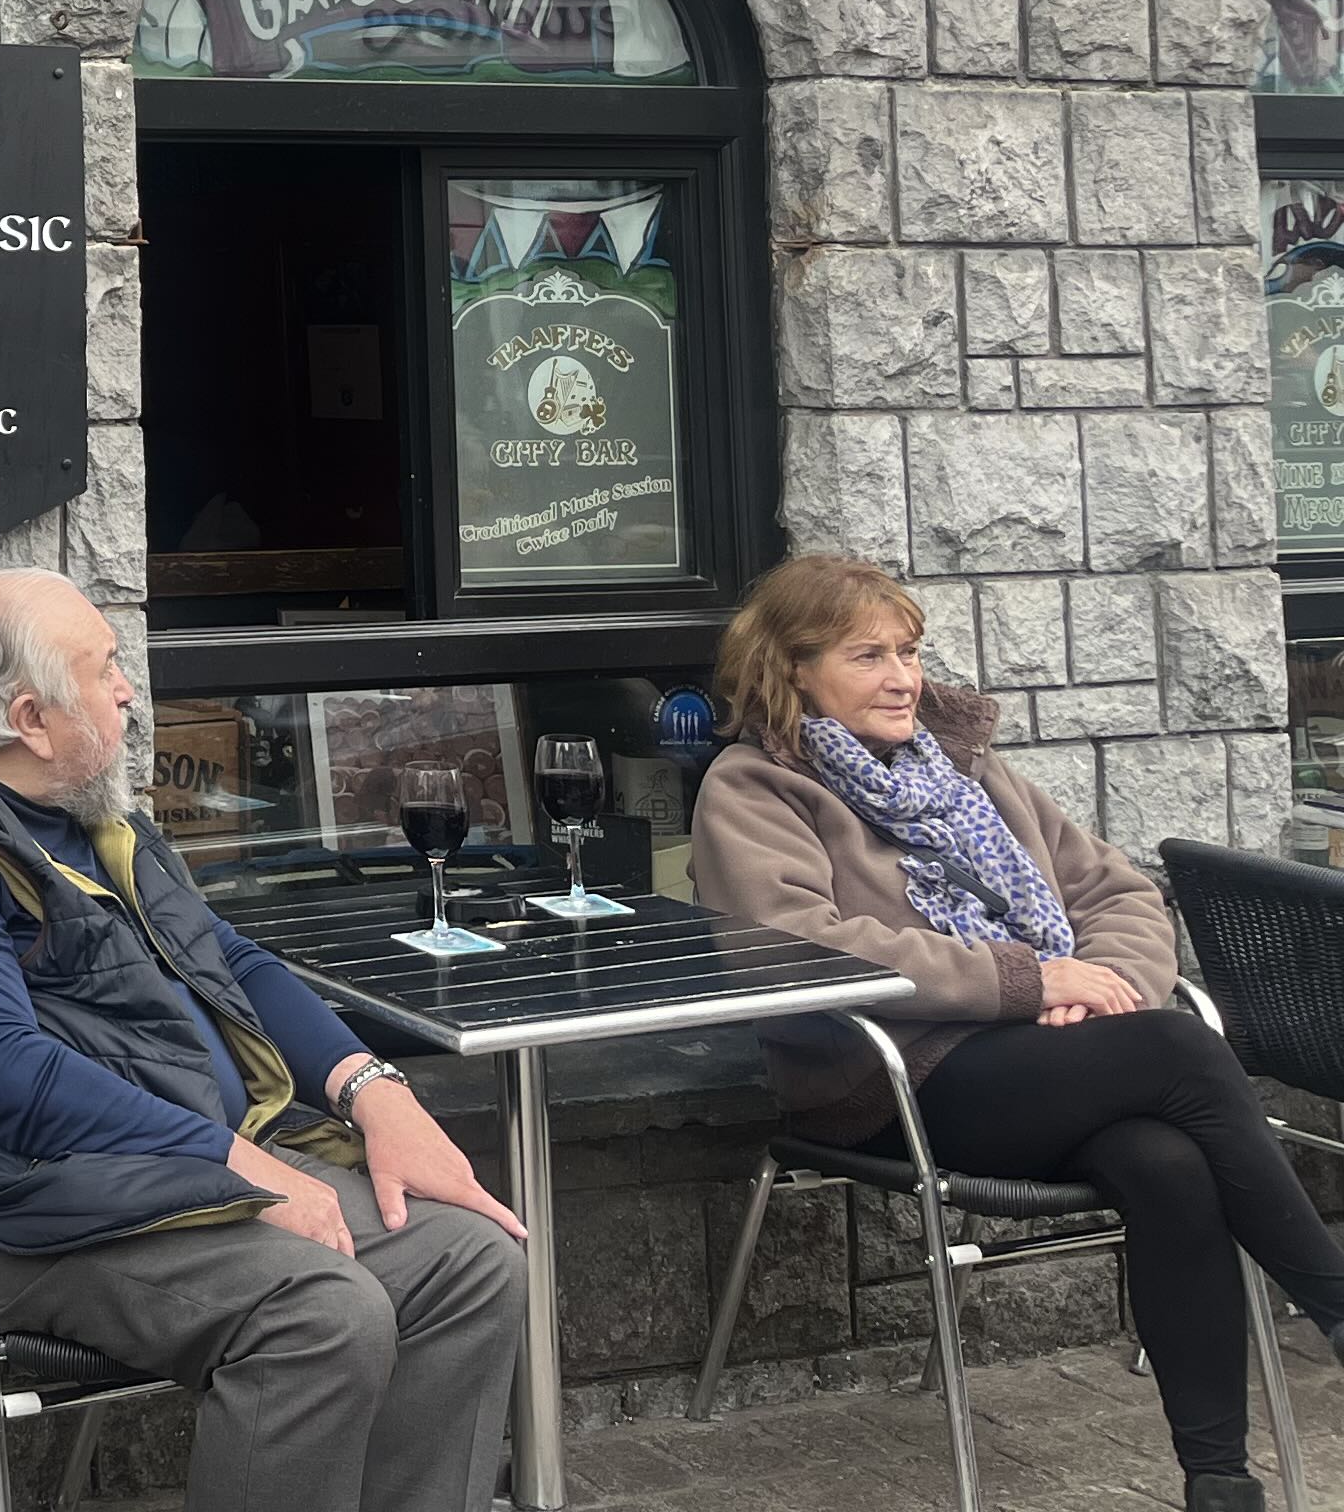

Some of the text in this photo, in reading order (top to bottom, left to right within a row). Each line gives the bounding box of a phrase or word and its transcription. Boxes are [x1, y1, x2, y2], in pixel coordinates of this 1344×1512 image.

[486, 324, 636, 373] TAAFFE'S
[490, 439, 639, 468] CITY BAR
[460, 475, 673, 543] Traditional Music Session
[516, 508, 619, 555] Twice Daily
